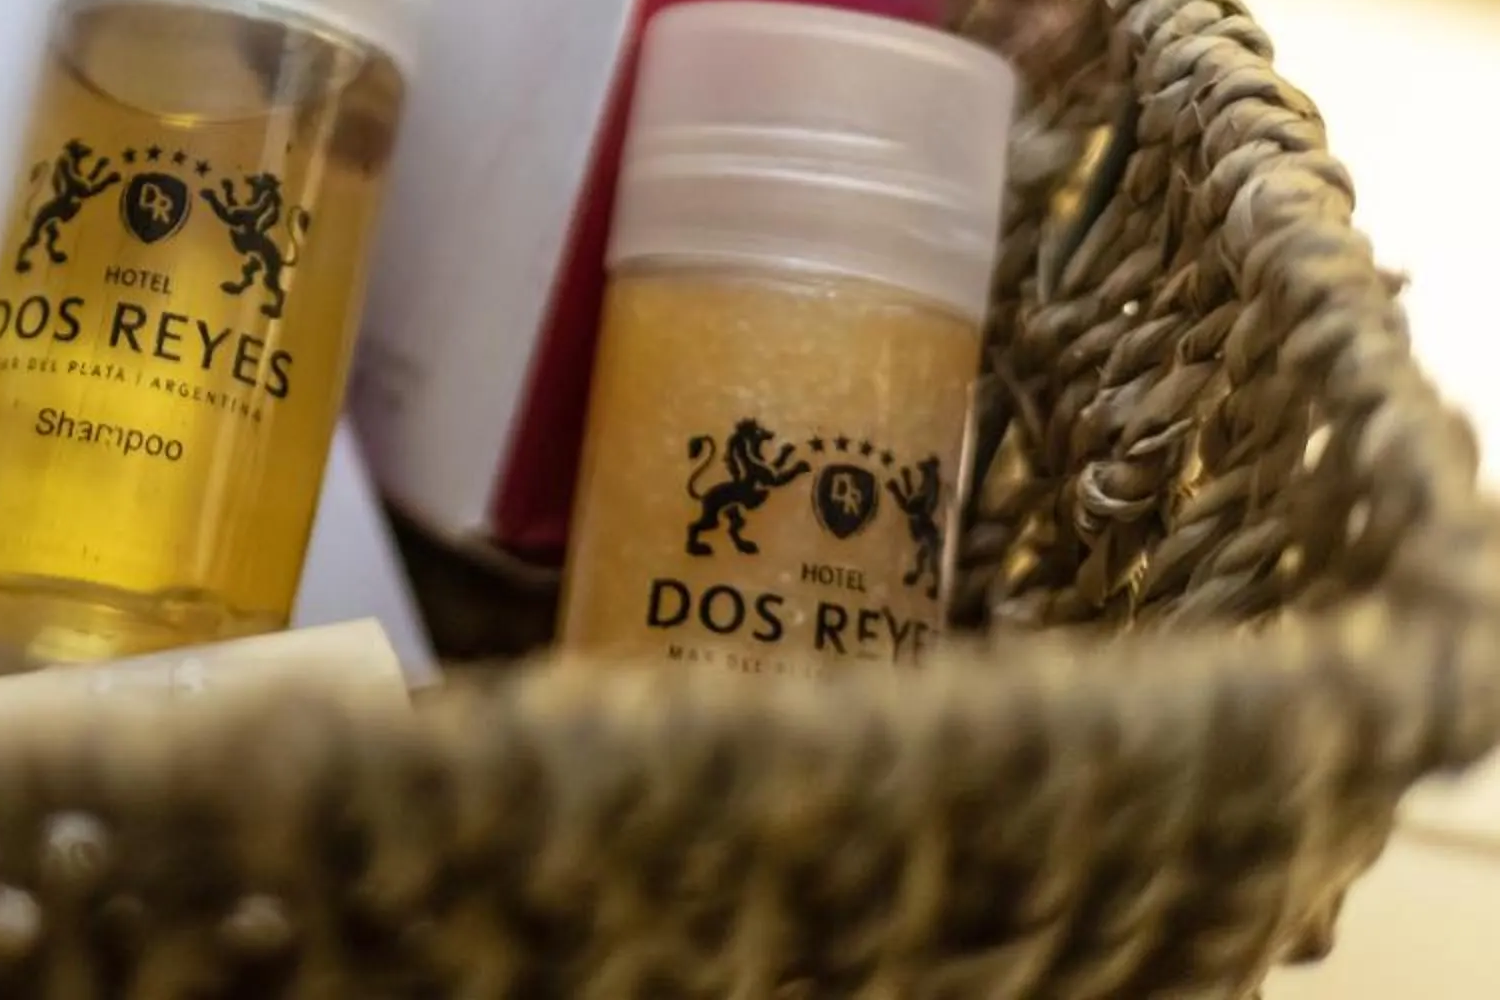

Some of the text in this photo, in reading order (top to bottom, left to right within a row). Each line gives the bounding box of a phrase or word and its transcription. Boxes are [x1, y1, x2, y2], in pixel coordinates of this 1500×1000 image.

[105, 264, 172, 295] HOTEL
[108, 301, 294, 400] REYES
[66, 360, 126, 383] PLATA
[149, 376, 262, 423] ARGENTINA
[34, 407, 184, 463] Shampoo
[800, 563, 868, 594] HOTEL
[647, 577, 941, 668] DOS REYE
